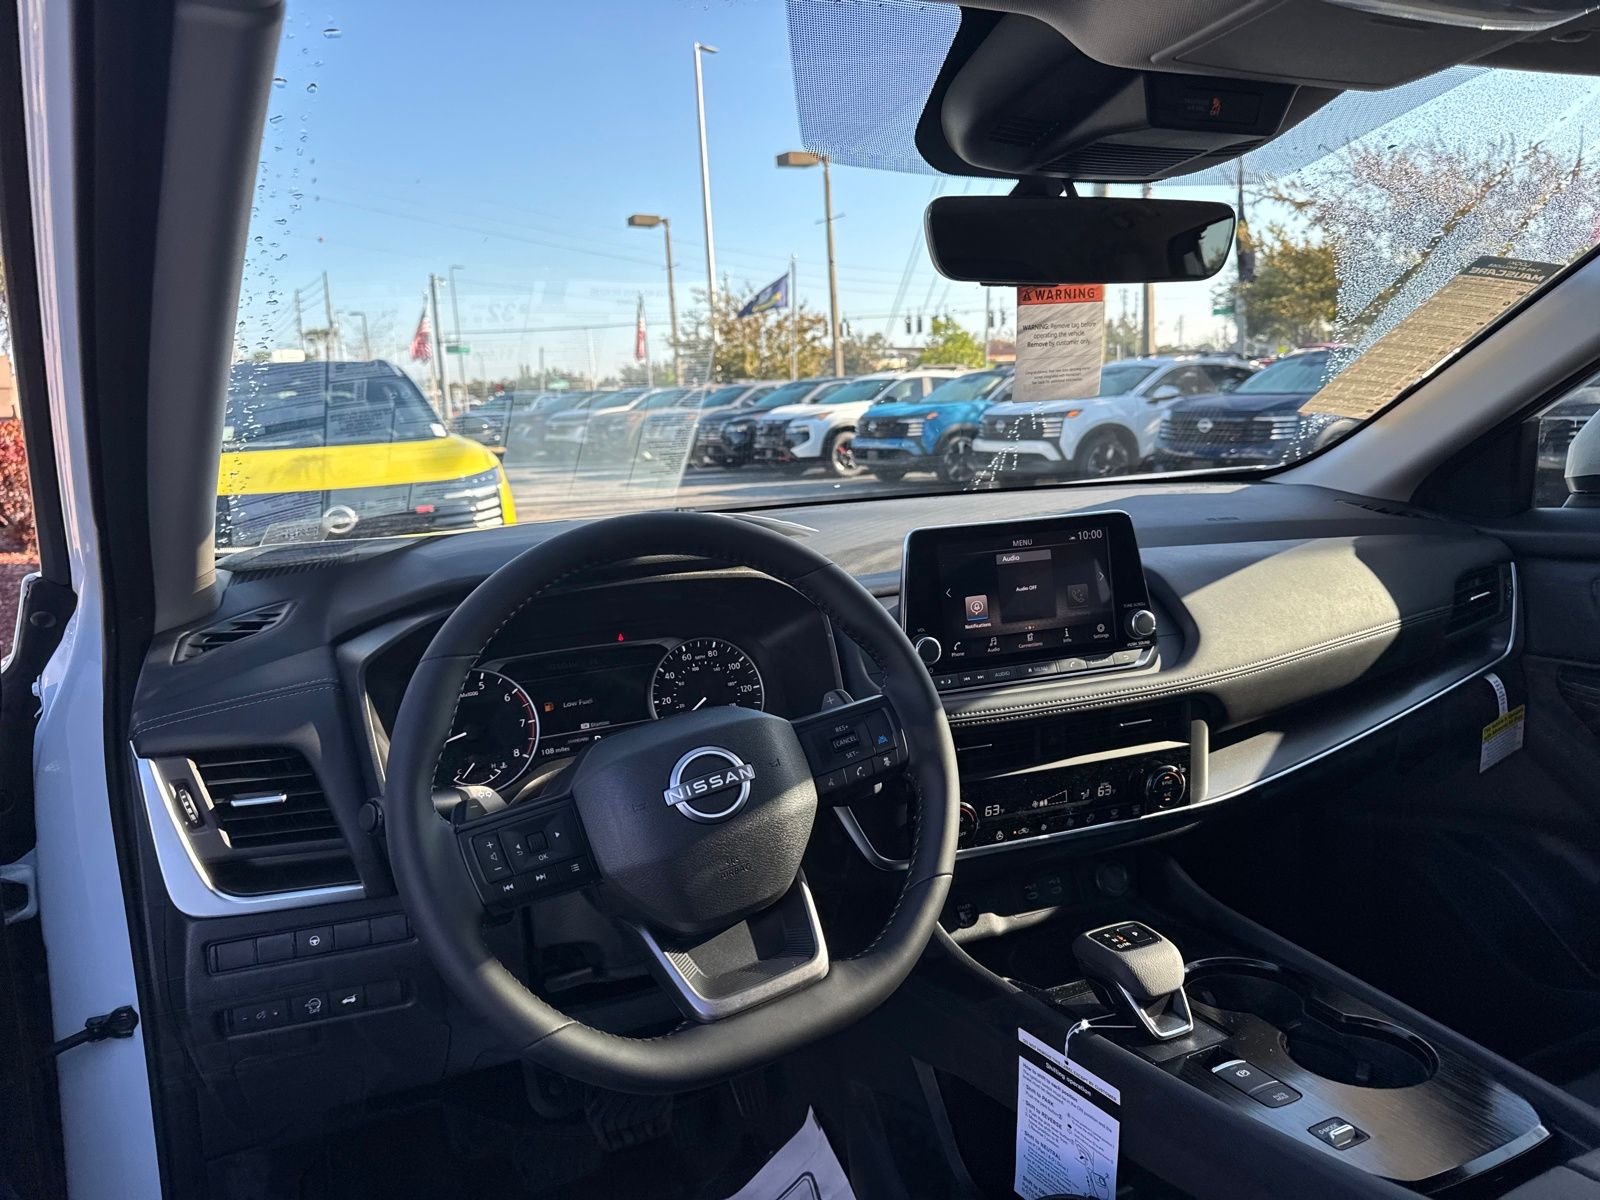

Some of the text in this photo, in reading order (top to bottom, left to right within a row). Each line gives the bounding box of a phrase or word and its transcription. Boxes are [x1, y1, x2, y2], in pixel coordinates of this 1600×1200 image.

[1035, 287, 1095, 300] WARNING
[1023, 323, 1049, 331] WARNING:
[1078, 530, 1102, 540] 10:00
[1012, 539, 1033, 547] MENU
[965, 622, 992, 630] Notifications
[681, 653, 692, 661] 60
[728, 662, 741, 670] 100
[995, 670, 1011, 678] AUDIO
[479, 682, 485, 690] 5
[740, 684, 753, 693] 120
[504, 693, 511, 702] 6
[662, 697, 672, 705] 20
[578, 698, 594, 706] Fuel
[520, 719, 525, 727] 7
[836, 736, 857, 746] CANCEL
[513, 749, 520, 757] 8
[541, 748, 555, 756] 108
[667, 767, 753, 802] NISSAN
[1098, 785, 1112, 797] 63
[985, 804, 1000, 817] 63
[1045, 1061, 1091, 1097] Shifting operation
[1025, 1083, 1036, 1095] Shift
[1041, 1094, 1053, 1107] PARK
[1041, 1110, 1062, 1130] REVERSE
[1040, 1141, 1061, 1161] NEUTRAL
